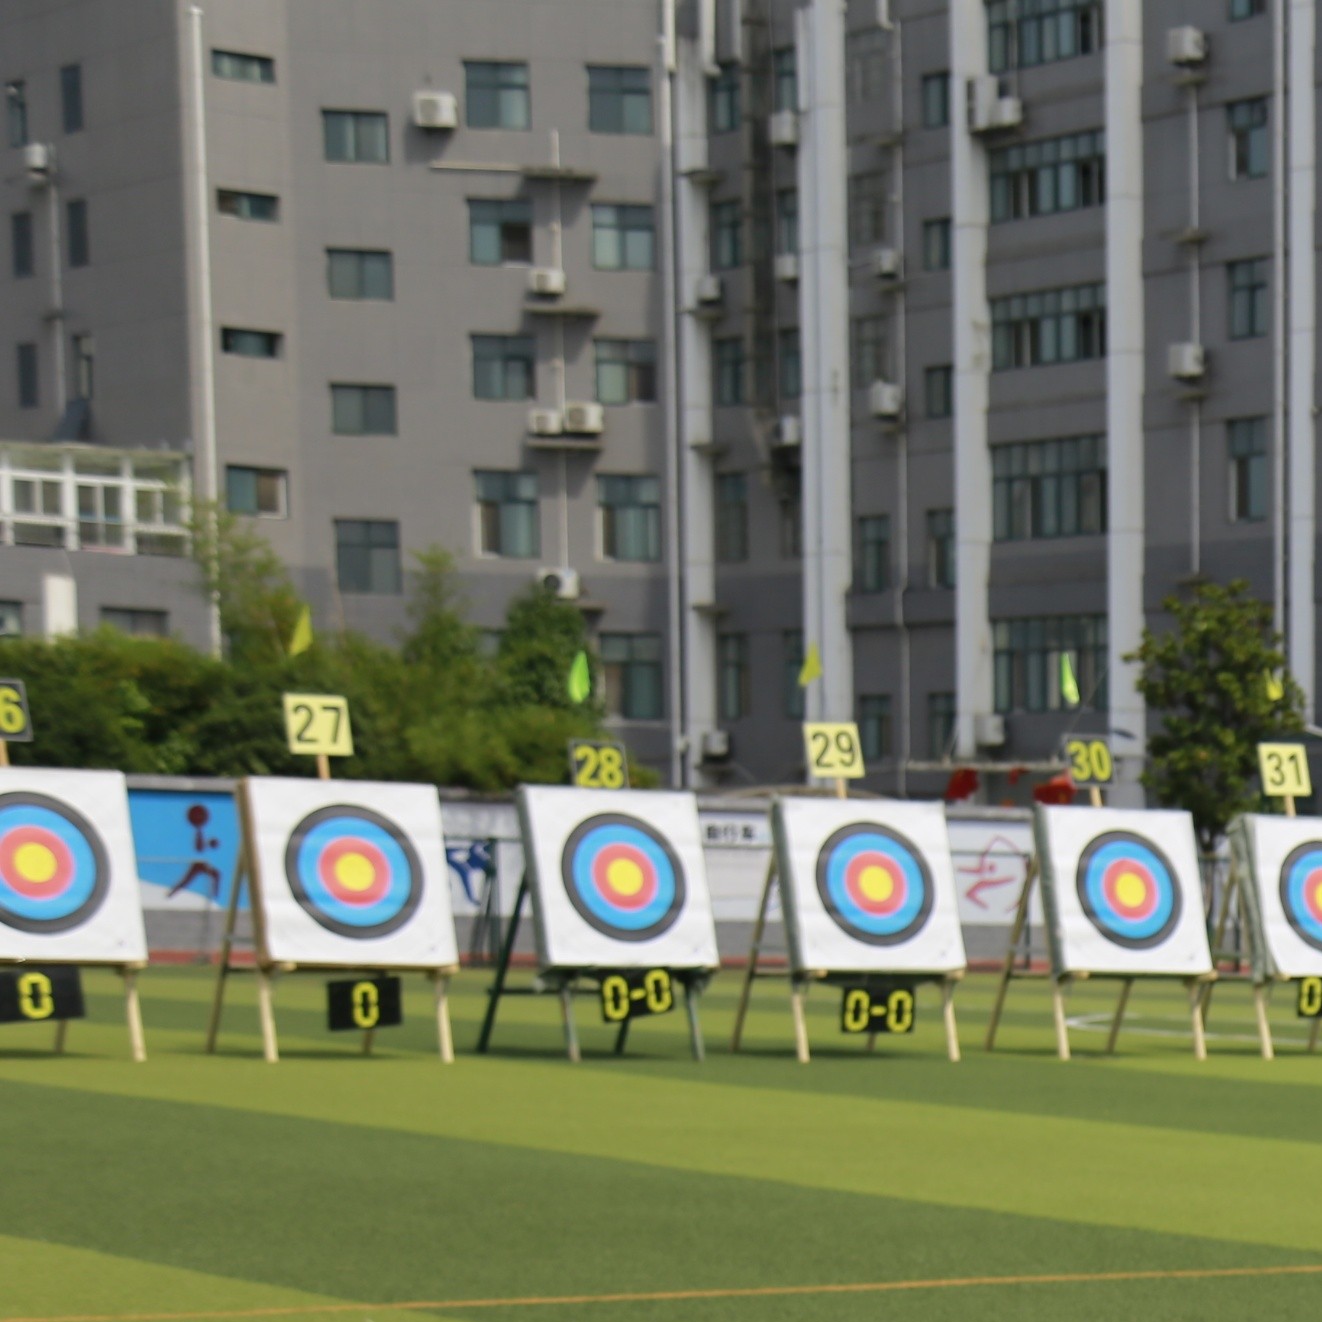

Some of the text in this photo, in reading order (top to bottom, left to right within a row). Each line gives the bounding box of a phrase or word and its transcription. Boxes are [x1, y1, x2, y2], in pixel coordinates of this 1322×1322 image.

[292, 704, 345, 744] 27
[574, 745, 624, 789] 28
[810, 731, 858, 768] 29
[1066, 739, 1113, 783] 30
[1267, 751, 1304, 787] 31
[18, 971, 54, 1020] 0
[352, 981, 379, 1028] 0
[602, 967, 672, 1021] 0-0
[844, 989, 914, 1032] 0-0
